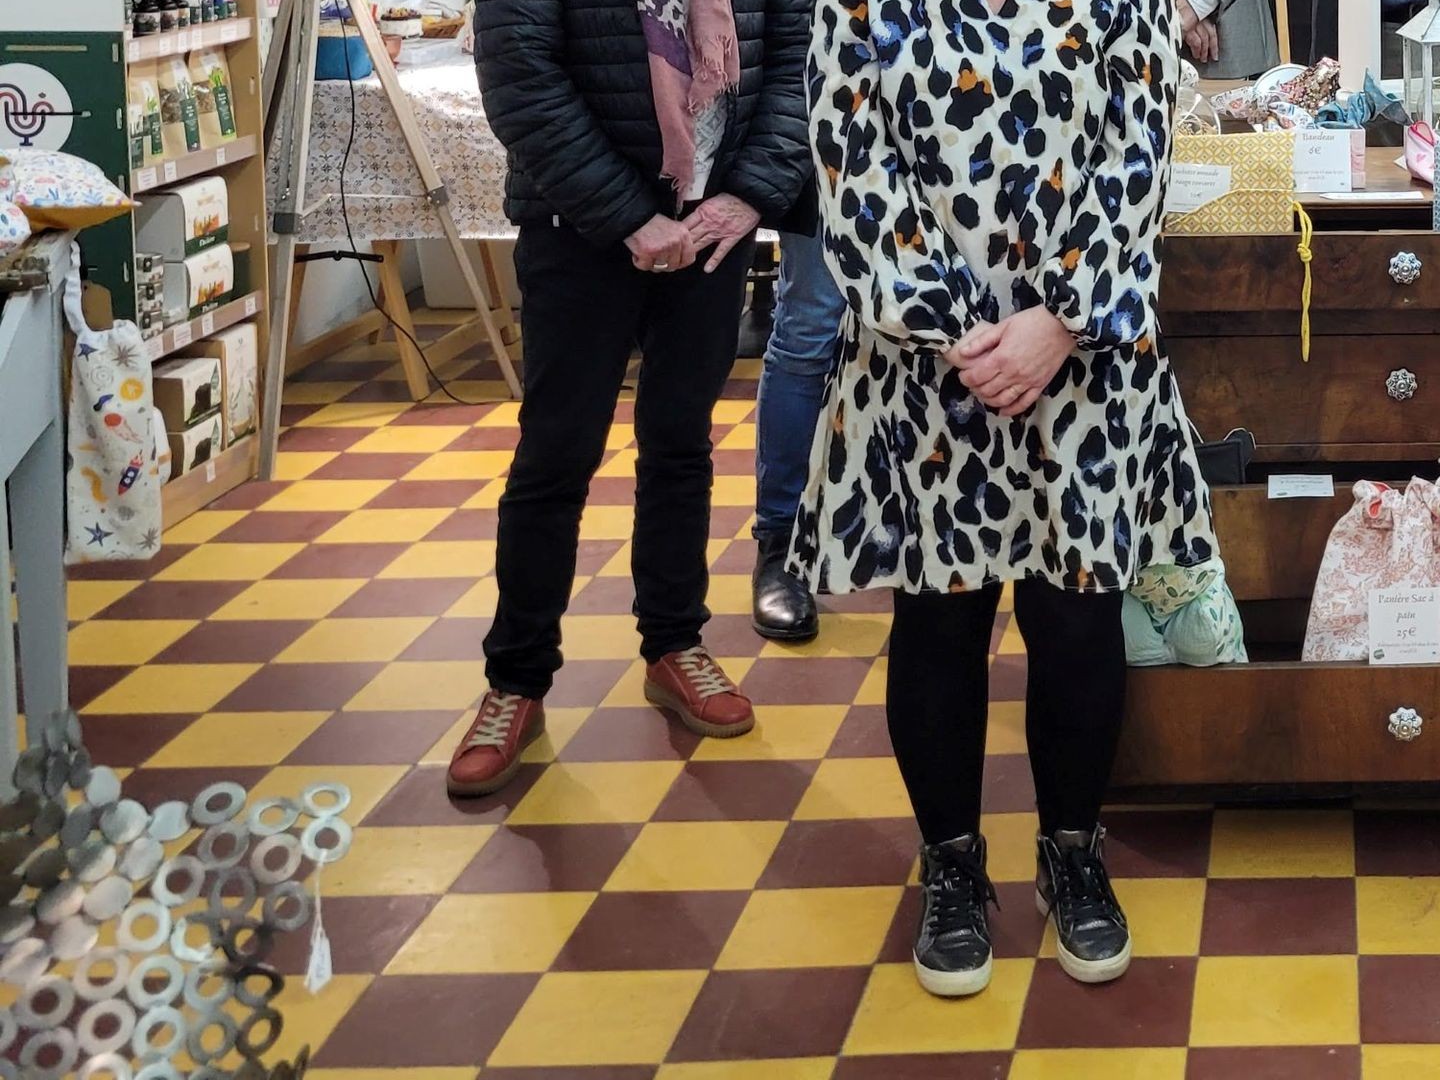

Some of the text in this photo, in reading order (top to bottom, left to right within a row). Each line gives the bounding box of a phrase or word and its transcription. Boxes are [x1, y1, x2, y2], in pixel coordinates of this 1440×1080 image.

[1302, 131, 1334, 140] Bandeau
[1378, 592, 1434, 603] Panière Sac à
[1396, 611, 1416, 623] pain
[1397, 627, 1416, 639] 25€
